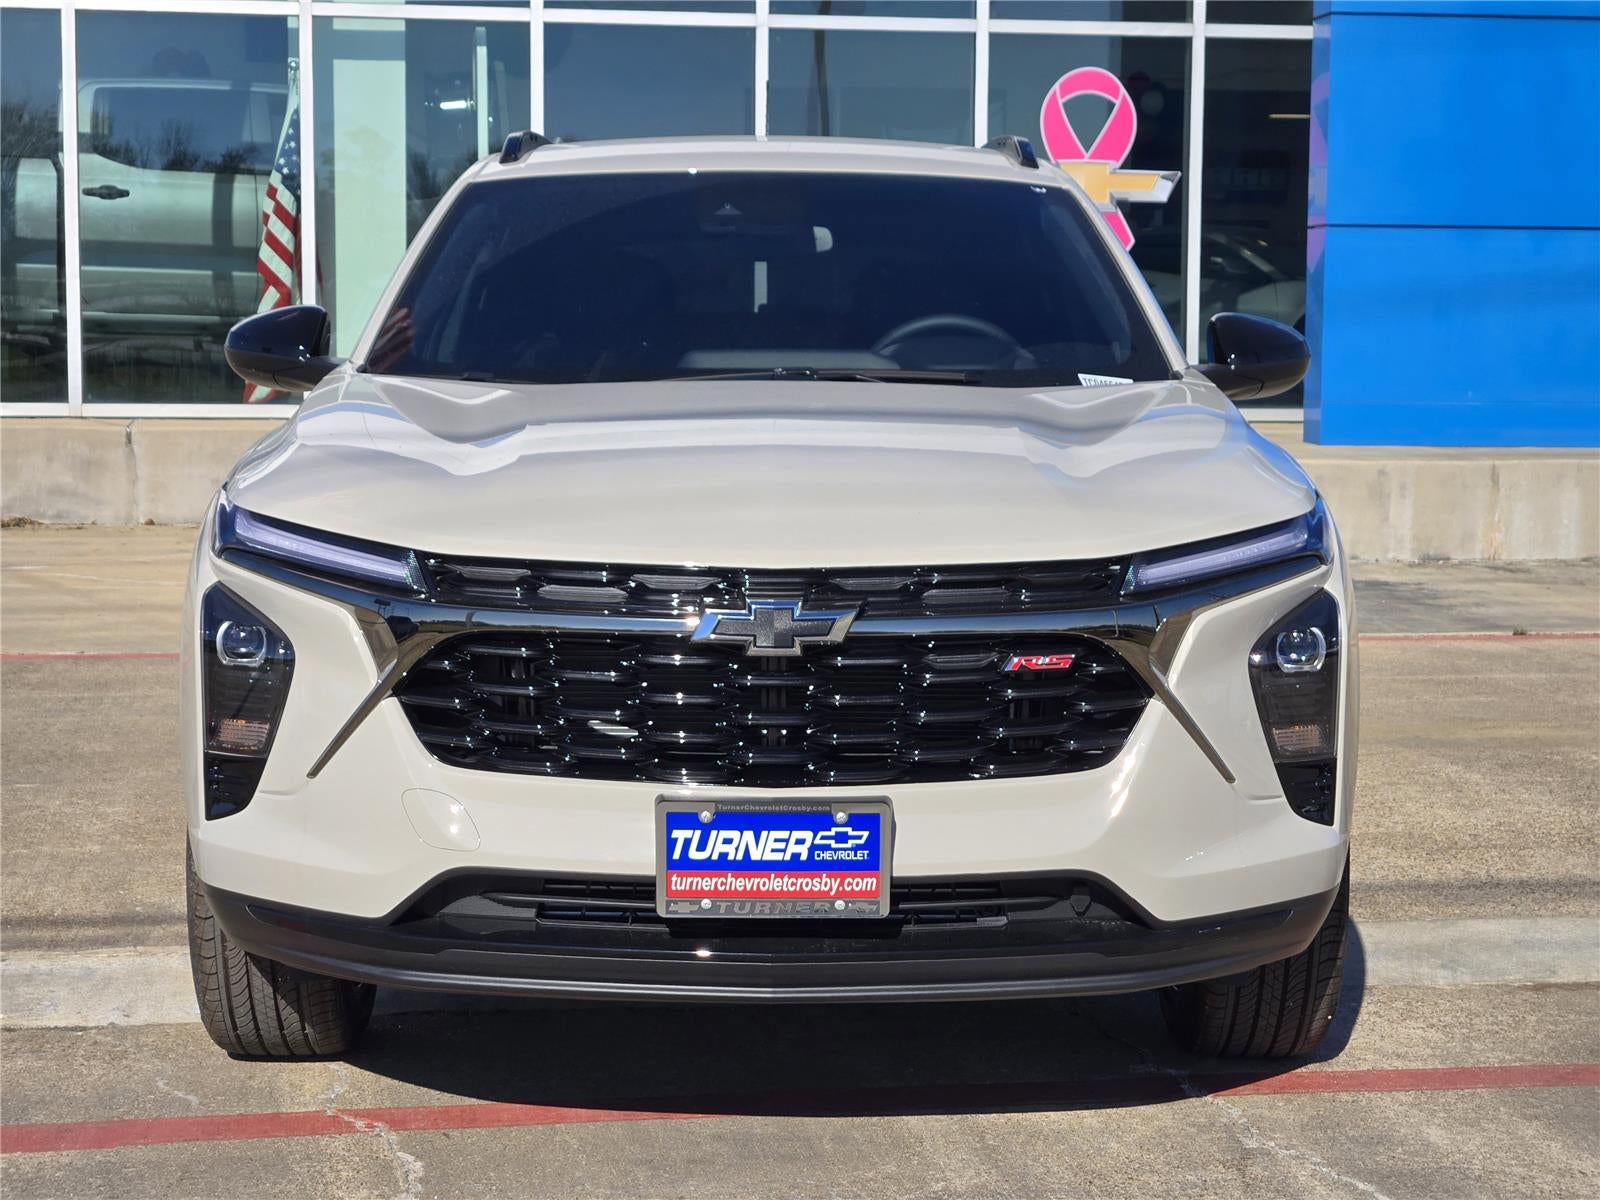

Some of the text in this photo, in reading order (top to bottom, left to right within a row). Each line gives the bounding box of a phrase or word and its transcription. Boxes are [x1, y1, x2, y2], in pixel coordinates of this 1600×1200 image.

[1002, 654, 1075, 672] RS
[717, 804, 831, 812] TurnerChevroletCrosby.com
[670, 829, 814, 861] TURNER
[814, 850, 869, 861] CHEVROLET
[671, 873, 876, 896] turnerchevroletcrosby.com
[717, 902, 831, 914] TURNER
